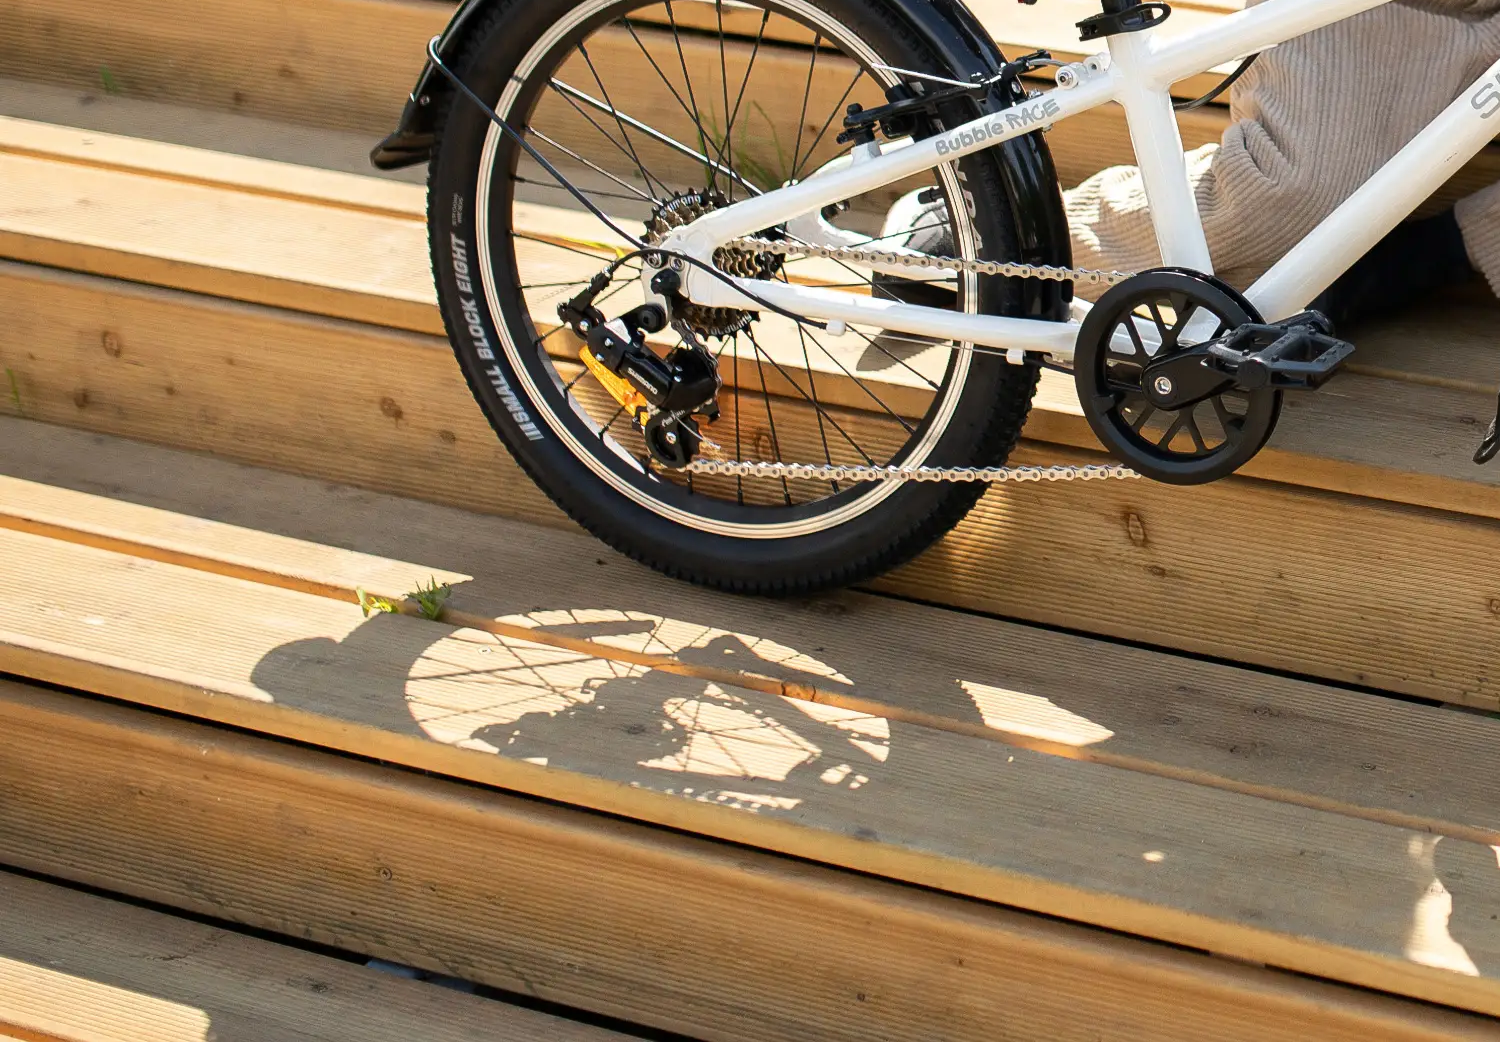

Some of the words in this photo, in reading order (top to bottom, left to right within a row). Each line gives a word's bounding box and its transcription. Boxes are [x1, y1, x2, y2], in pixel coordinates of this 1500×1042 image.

[935, 121, 1004, 155] Bubble
[1005, 98, 1060, 130] RACE
[450, 232, 473, 294] EIGHT
[459, 296, 495, 360] BLOCK
[485, 365, 530, 423] SMALL
[627, 367, 658, 395] SHIMANO
